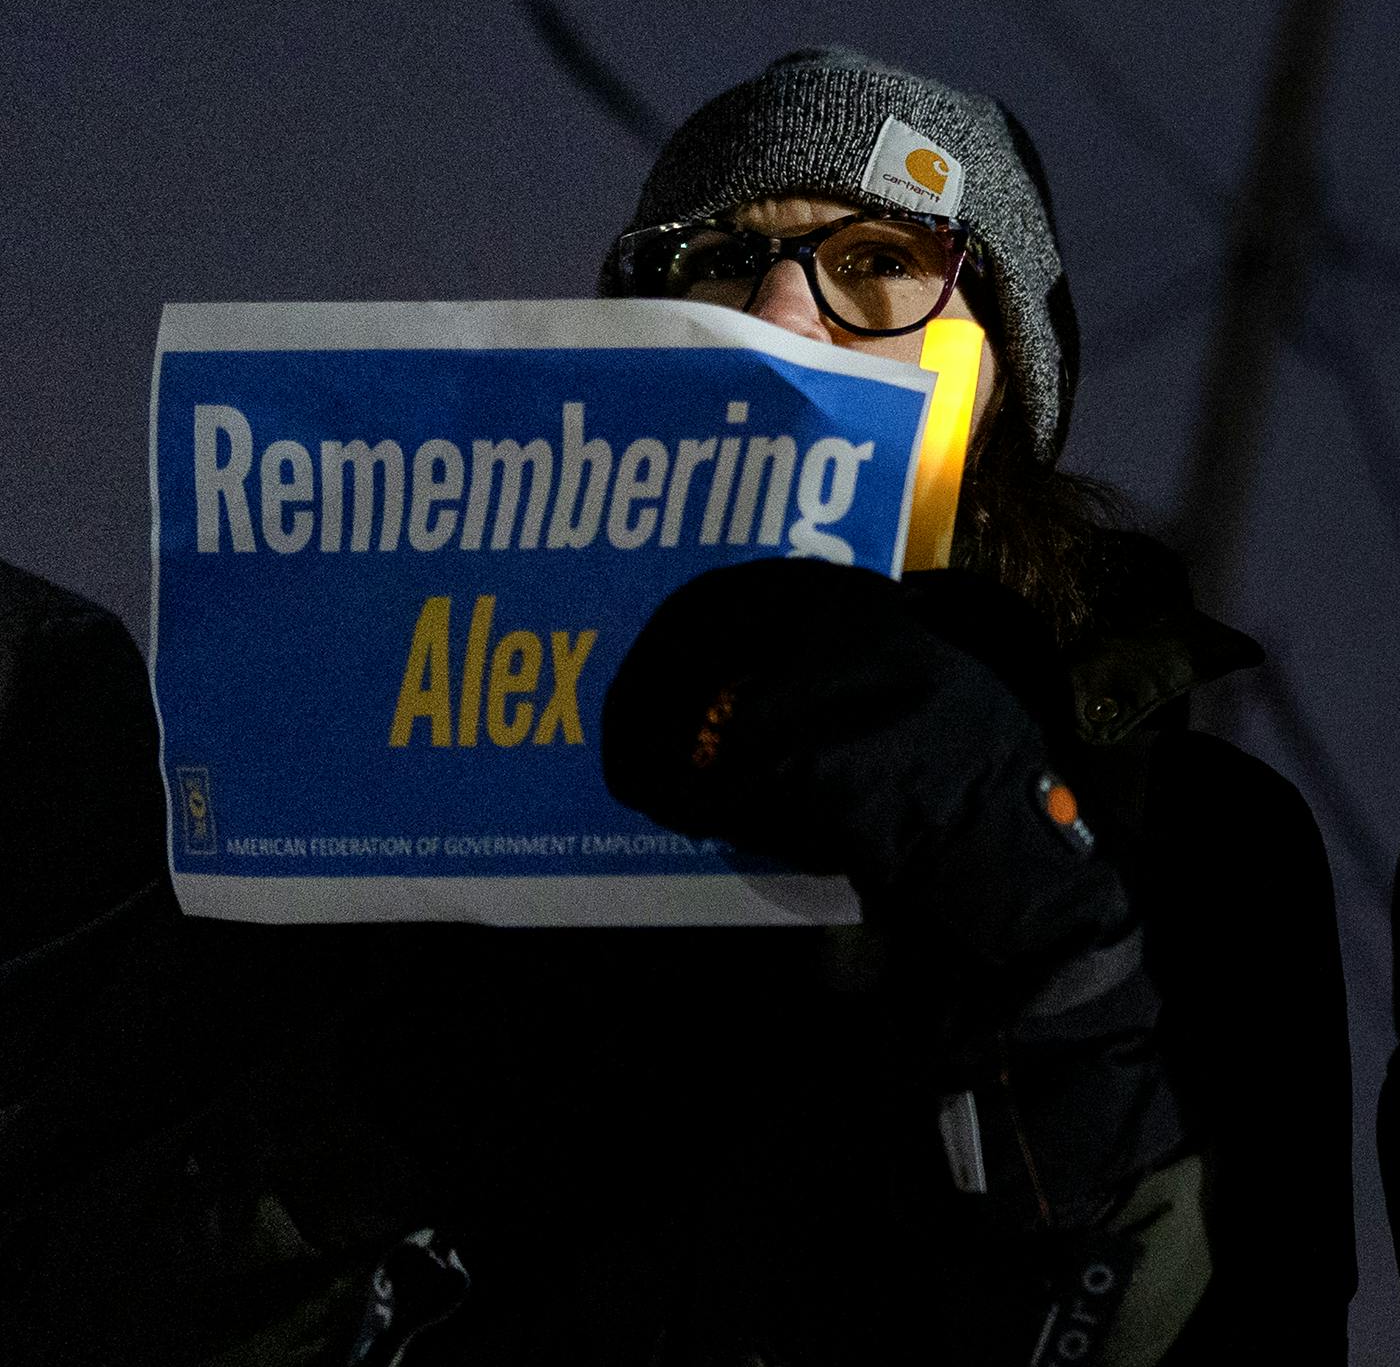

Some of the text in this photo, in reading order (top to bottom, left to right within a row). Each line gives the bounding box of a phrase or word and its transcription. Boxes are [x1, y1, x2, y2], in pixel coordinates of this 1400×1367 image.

[882, 173, 940, 203] carhartt
[193, 401, 874, 567] Remembering
[389, 595, 599, 748] Alex
[226, 837, 306, 856] AMERICAN
[310, 837, 412, 856] FEDERATION
[416, 837, 441, 856] OF
[444, 835, 577, 856] GOVERNMENT
[1047, 1261, 1117, 1367] oro
